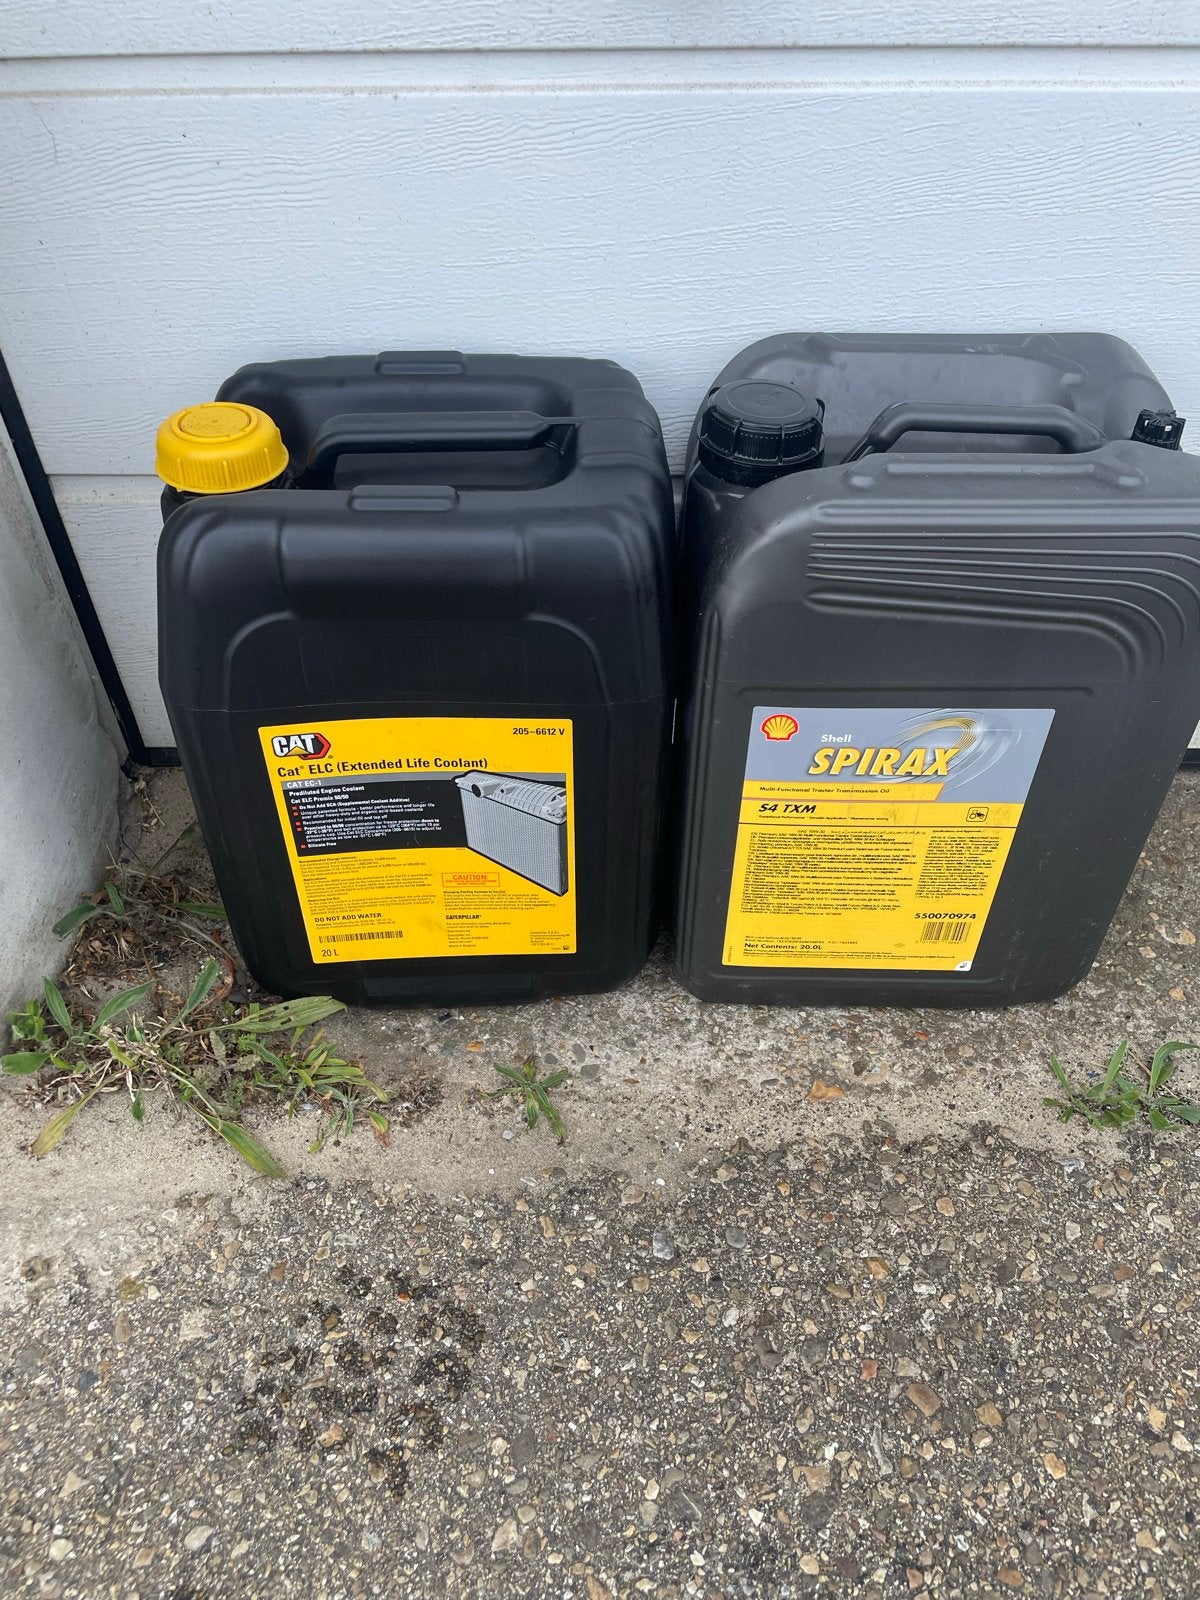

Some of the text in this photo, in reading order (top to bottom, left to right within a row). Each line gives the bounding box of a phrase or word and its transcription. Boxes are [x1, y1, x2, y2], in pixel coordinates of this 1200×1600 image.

[272, 734, 314, 757] CAT
[821, 734, 852, 742] Shell
[308, 764, 333, 774] ELC
[337, 759, 402, 773] (Extended
[407, 758, 430, 768] Life
[434, 758, 488, 769] Coolant)
[808, 747, 960, 776] SPIRAX
[759, 804, 816, 814] S4 TXM
